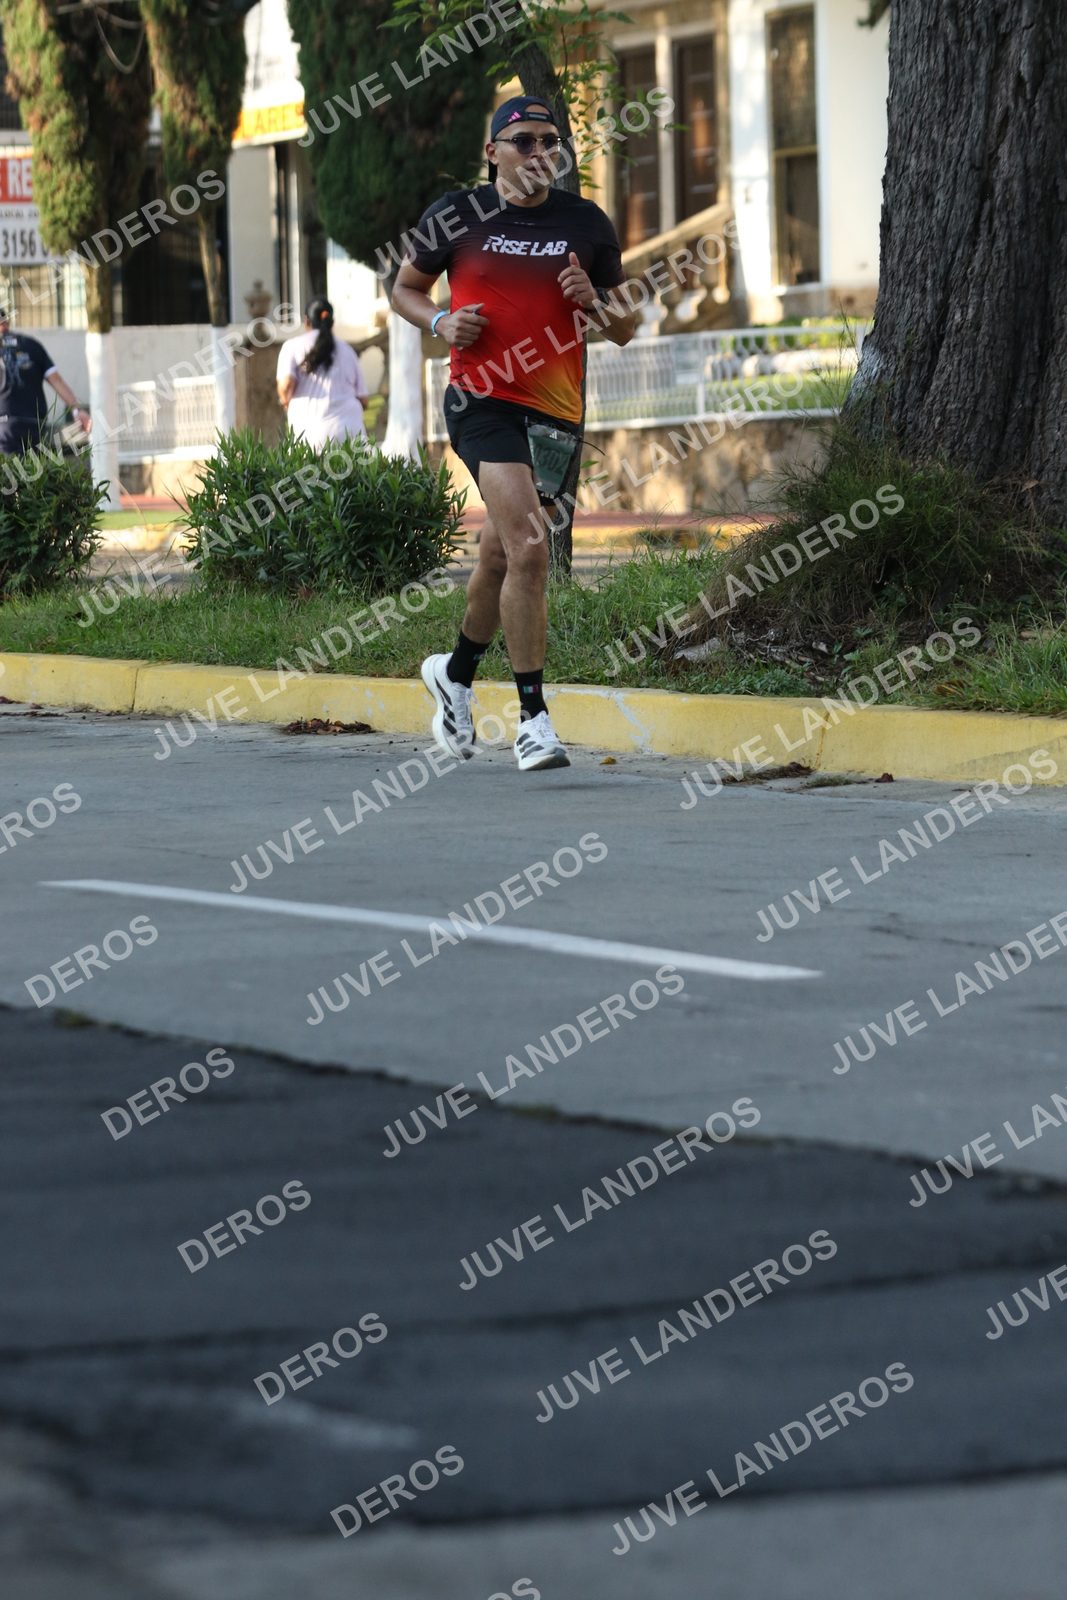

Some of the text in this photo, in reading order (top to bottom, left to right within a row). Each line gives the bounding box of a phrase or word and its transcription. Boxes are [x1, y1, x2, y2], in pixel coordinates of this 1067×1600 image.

[2, 228, 37, 258] 3156
[482, 234, 568, 256] RISE LAB
